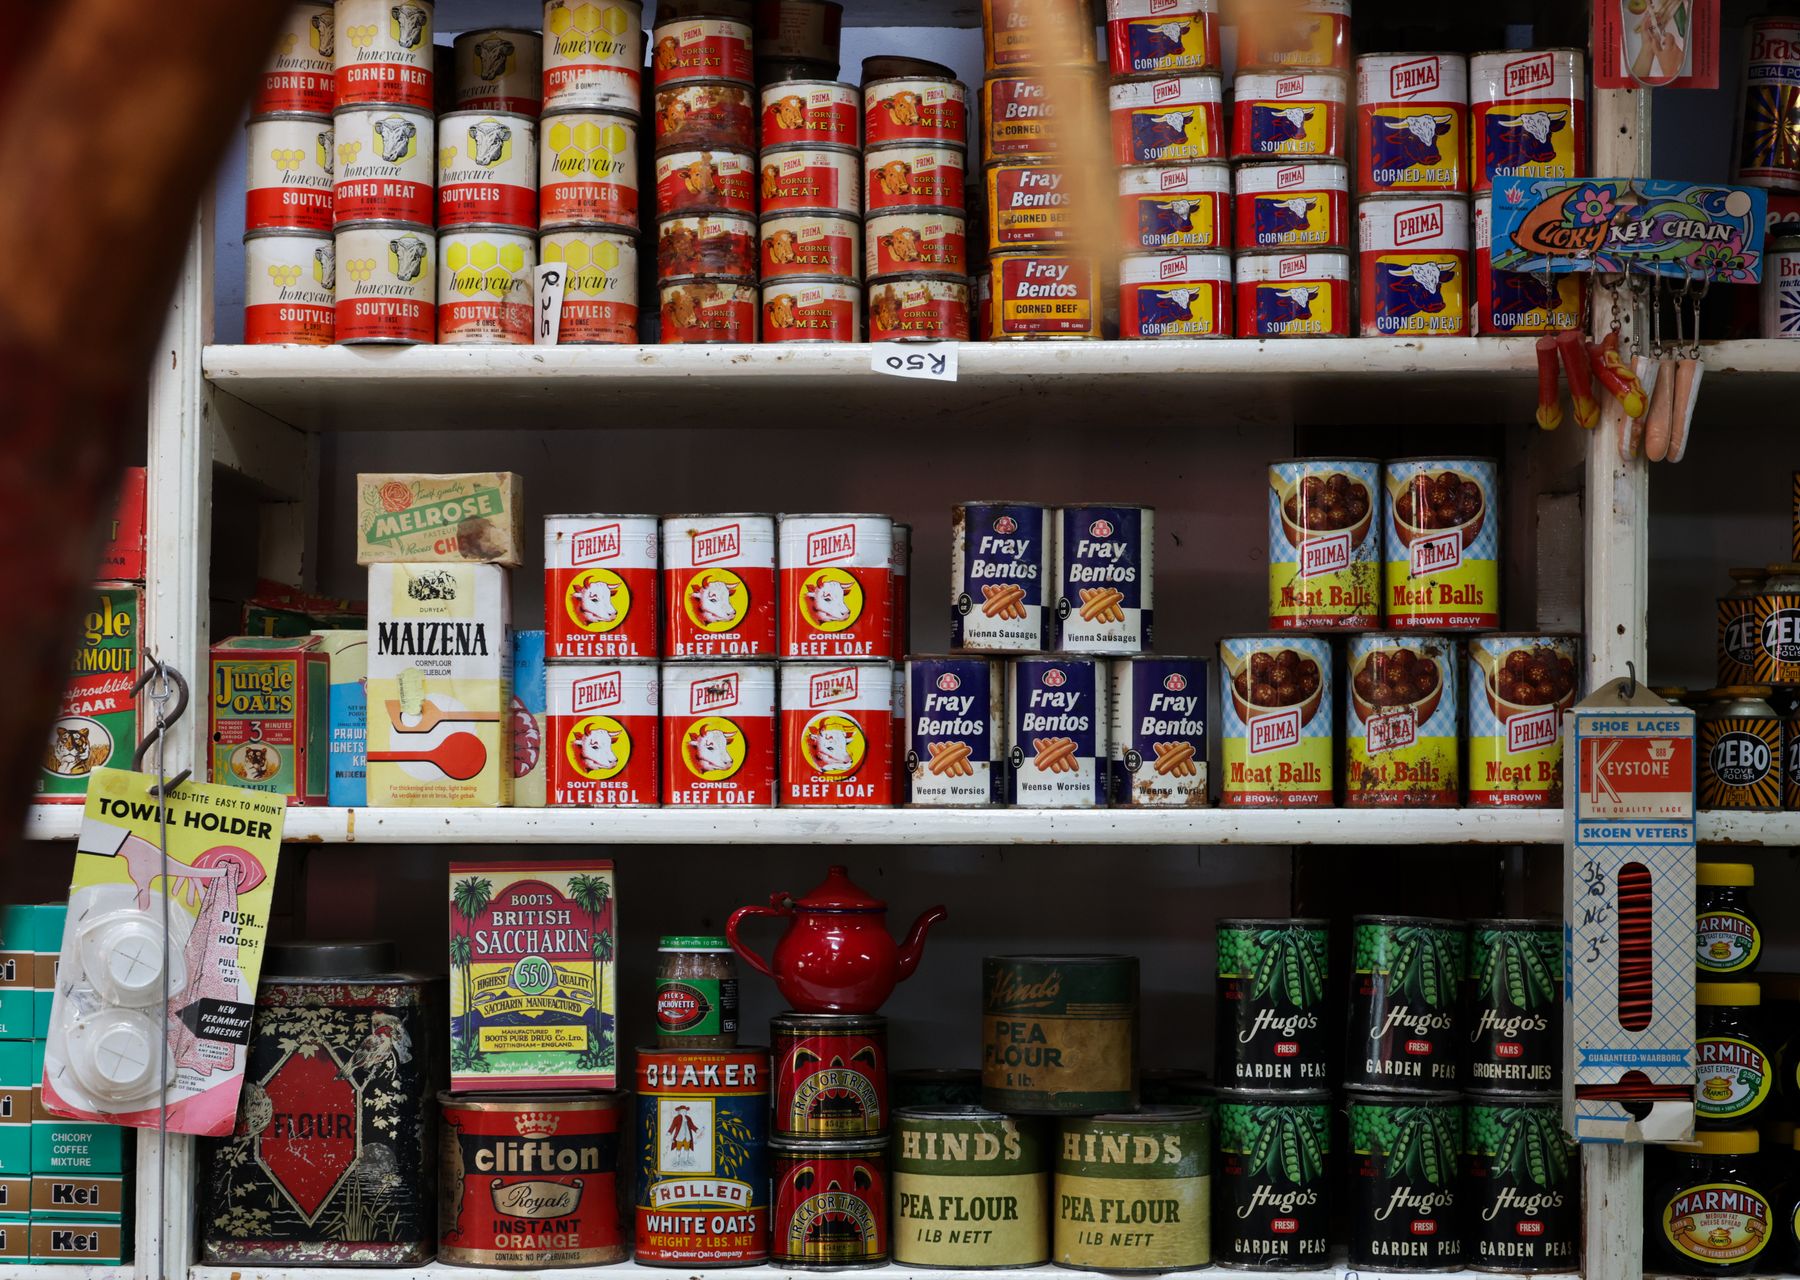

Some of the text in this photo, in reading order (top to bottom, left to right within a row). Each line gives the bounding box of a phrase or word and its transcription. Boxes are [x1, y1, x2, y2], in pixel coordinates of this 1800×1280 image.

[357, 47, 416, 63] honeycure
[553, 35, 627, 58] honeycure
[347, 68, 426, 84] CORNED MEAT
[1396, 65, 1435, 89] PRIMA
[1509, 62, 1549, 87] PRIMA
[812, 90, 831, 104] PRIMA
[806, 122, 845, 133] MEAT
[1373, 169, 1456, 182] CORNED-MEAT
[1610, 219, 1655, 243] KEY
[1663, 220, 1736, 240] CHAIN
[1025, 262, 1069, 282] Fray
[1017, 281, 1077, 298] Bentos
[355, 302, 419, 317] SOUTVLEIS
[1016, 303, 1078, 314] CORNED BEEF
[376, 495, 491, 537] MELROSE
[578, 533, 616, 557] PRIMA
[698, 534, 736, 557] PRIMA
[980, 536, 1029, 556] Fray
[1417, 541, 1456, 566] PRIMA
[971, 560, 1037, 579] Bentos
[1394, 584, 1483, 605] Meat Balls
[1407, 617, 1443, 625] BROWN
[1449, 617, 1480, 625] GRAVY
[378, 622, 488, 656] MAIZENA
[969, 630, 1037, 640] Vienna Sausages
[556, 642, 638, 656] VLEISROL
[677, 642, 759, 655] BEEF LOAF
[217, 666, 292, 704] Jungle
[234, 695, 292, 711] OATS
[925, 694, 974, 716] Fray
[251, 721, 262, 741] 3
[917, 717, 983, 736] Bentos
[1256, 721, 1294, 744] PRIMA
[1592, 722, 1680, 732] SHOE LACES
[1718, 741, 1768, 769] ZEBO
[1231, 762, 1321, 782] Meat Balls
[1591, 740, 1669, 803] KEYSTONE
[917, 787, 985, 795] Weense Worsies
[216, 797, 236, 809] EASY
[240, 800, 251, 809] TO
[254, 803, 281, 816] MOUNT
[184, 812, 272, 840] HOLDER
[1583, 828, 1688, 838] SKOEN VETERS
[511, 895, 552, 906] BOOTS
[493, 911, 570, 926] BRITISH
[233, 927, 241, 935] IT
[219, 935, 259, 949] HOLDS!
[476, 929, 588, 953] SACCHARIN
[477, 975, 590, 989] HIGHEST QUALITY
[520, 964, 548, 987] 550
[218, 1005, 236, 1014] NEW
[484, 999, 581, 1015] SACCHARIN MANUFACTURED
[658, 1001, 694, 1012] ANCHOVETTE
[201, 1014, 249, 1028] PERMANENT
[1239, 1009, 1318, 1043] Hugo's
[1471, 1009, 1547, 1043] Hugo's
[204, 1025, 243, 1039] ADHESIVE
[995, 1023, 1047, 1043] PEA
[986, 1047, 1063, 1067] FLOUR
[1278, 1044, 1296, 1053] FRESH
[1500, 1045, 1518, 1054] VARS
[1588, 1052, 1681, 1063] GUARANTEED-WAARBORG
[647, 1064, 756, 1087] QUAKER
[1236, 1063, 1326, 1078] GARDEN PEAS
[1473, 1063, 1551, 1079] GROEN-ERTJIES
[1698, 1066, 1740, 1074] YEAST EXTRACT
[794, 1074, 877, 1117] TRICK OR TREACLE
[274, 1113, 354, 1138] FLOUR
[51, 1133, 92, 1143] CHICORY
[902, 1131, 1021, 1160] HINDS
[54, 1146, 88, 1154] COFFEE
[475, 1142, 598, 1171] clifton
[1064, 1133, 1182, 1163] HINDS
[51, 1158, 91, 1167] MIXTURE
[660, 1185, 741, 1200] ROLLED
[901, 1193, 1018, 1221] PEA FLOUR
[1062, 1194, 1180, 1223] PEA FLOUR
[1676, 1192, 1763, 1217] MARMITE
[494, 1220, 581, 1233] INSTANT
[647, 1215, 755, 1234] WHITE OATS
[52, 1232, 98, 1251] Kei
[495, 1234, 578, 1248] ORANGE
[650, 1236, 752, 1247] WEIGHT 2 LBS. NET
[918, 1230, 992, 1243] 1 LB NETT
[660, 1250, 671, 1258] The
